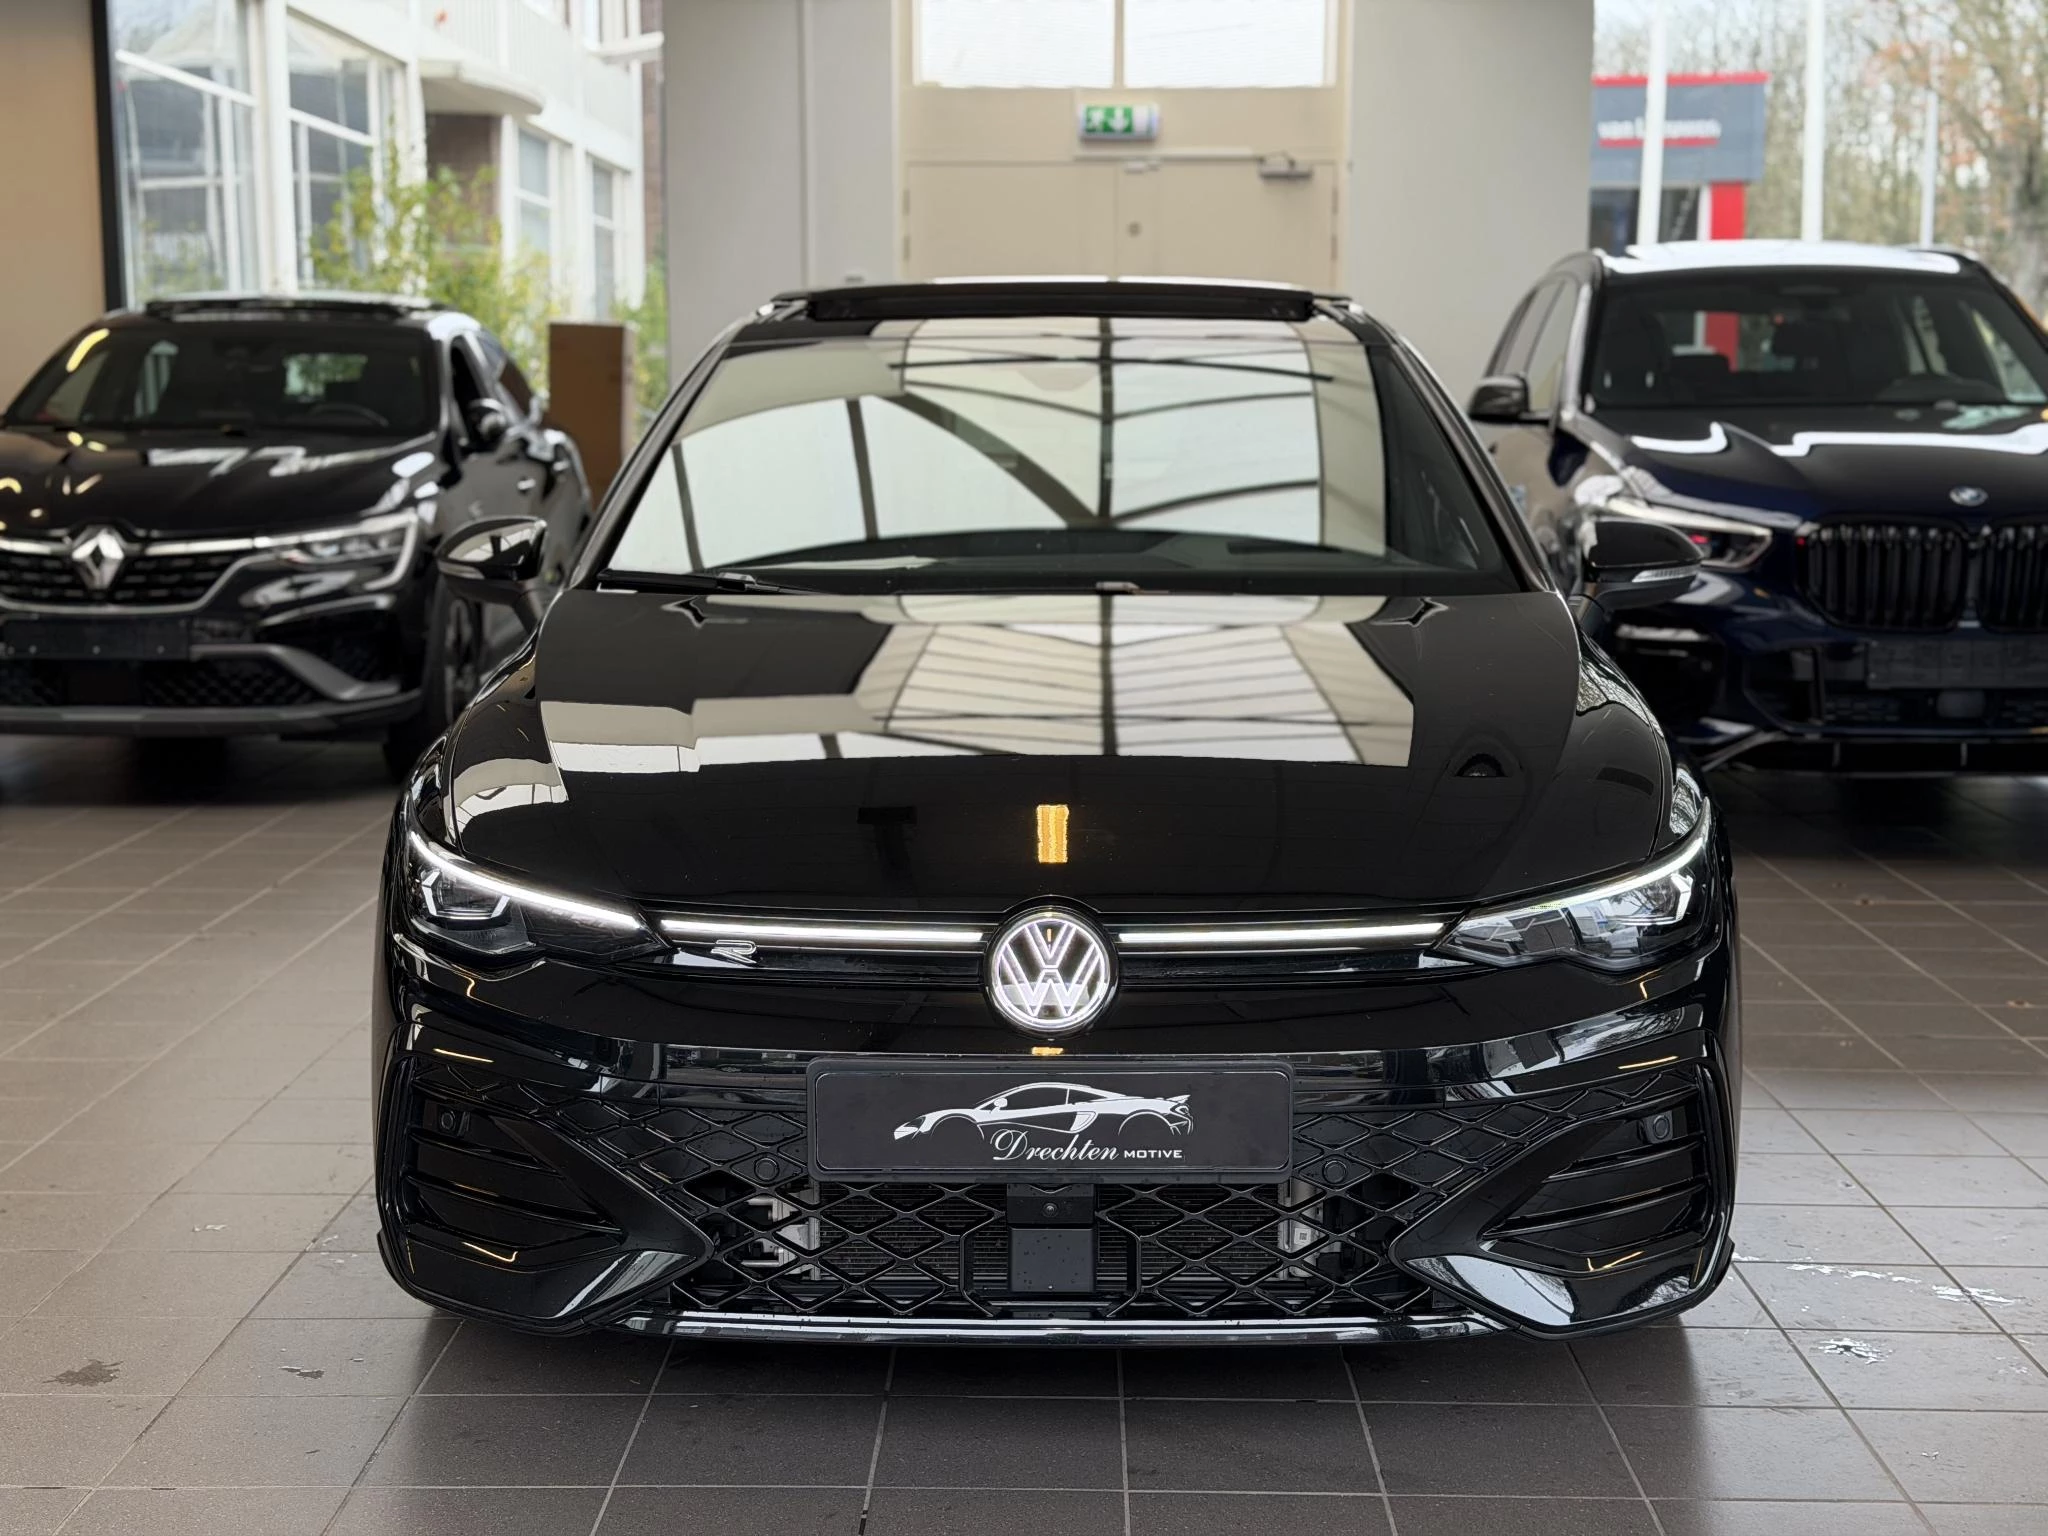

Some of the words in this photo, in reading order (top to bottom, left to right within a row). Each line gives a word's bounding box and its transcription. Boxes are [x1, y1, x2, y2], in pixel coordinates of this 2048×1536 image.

[710, 939, 758, 964] R
[999, 920, 1102, 1018] VW
[990, 1128, 1119, 1161] Drechten
[1124, 1149, 1183, 1159] MOTIVE
